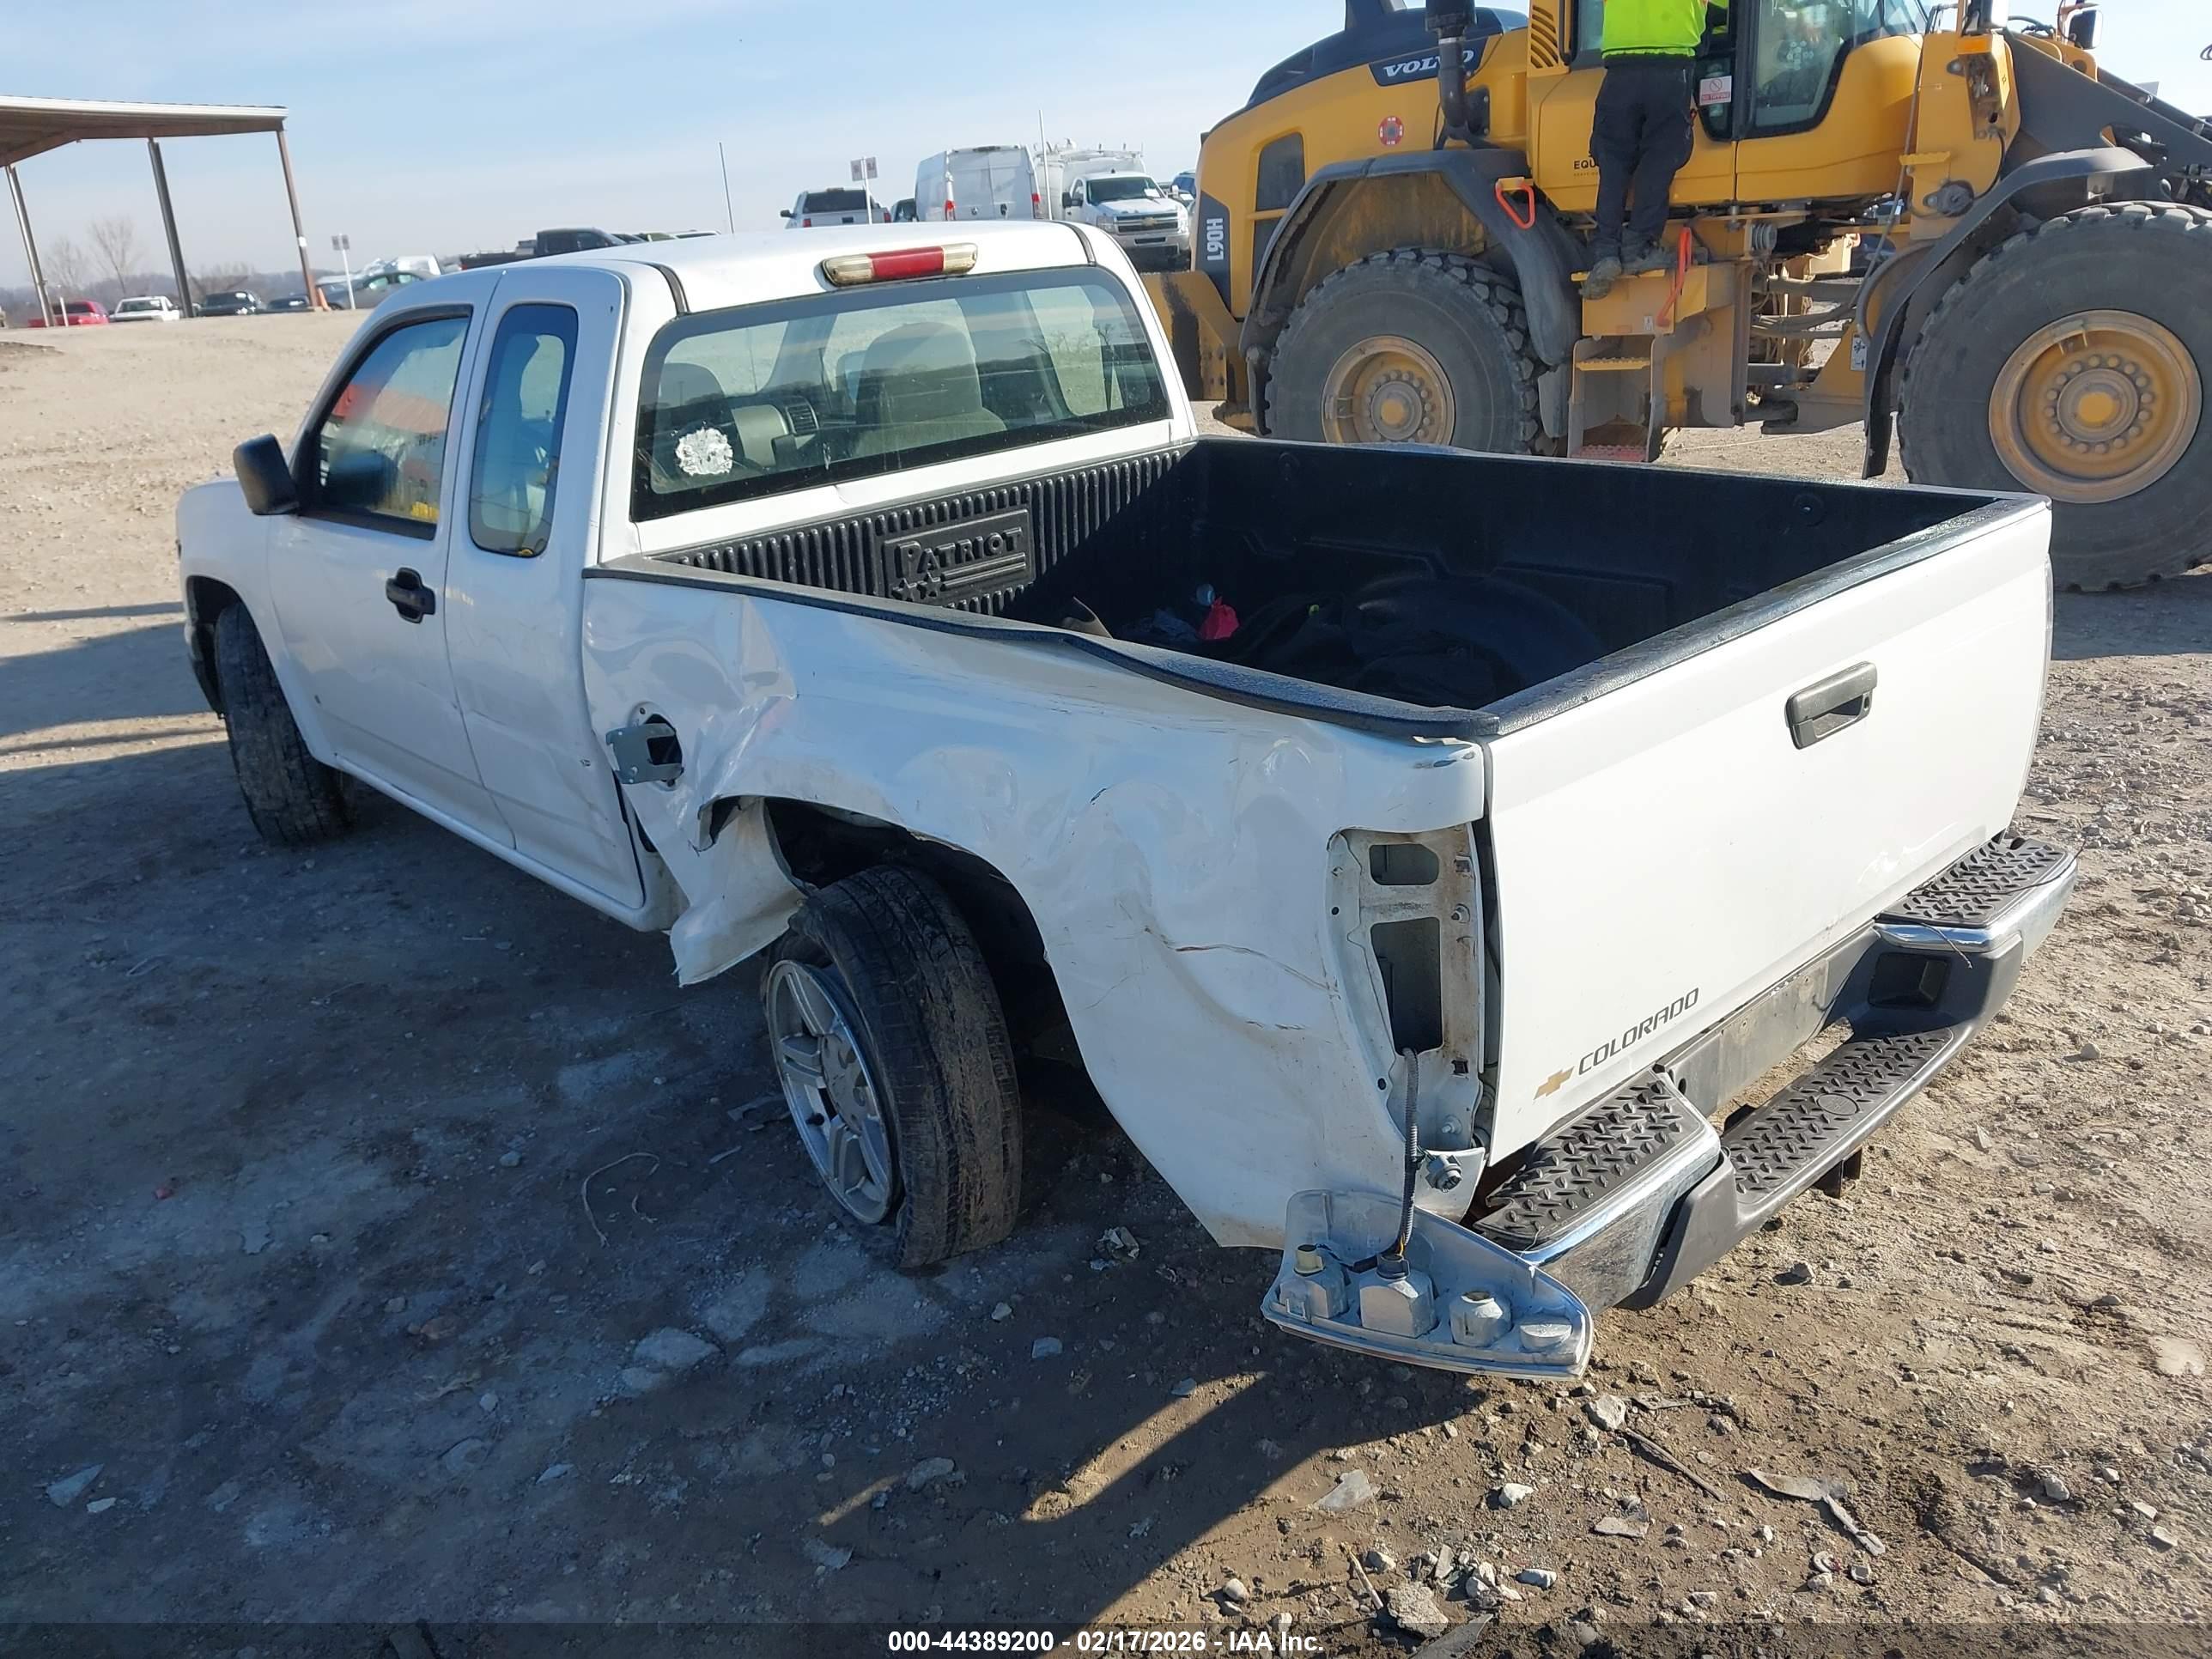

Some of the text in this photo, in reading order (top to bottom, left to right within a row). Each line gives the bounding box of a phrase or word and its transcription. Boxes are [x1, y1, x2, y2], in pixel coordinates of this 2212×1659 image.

[1383, 50, 1474, 77] VOLO
[1206, 218, 1224, 260] L90H
[896, 526, 1022, 584] PATRIOT
[1579, 988, 1698, 1075] COLORADO
